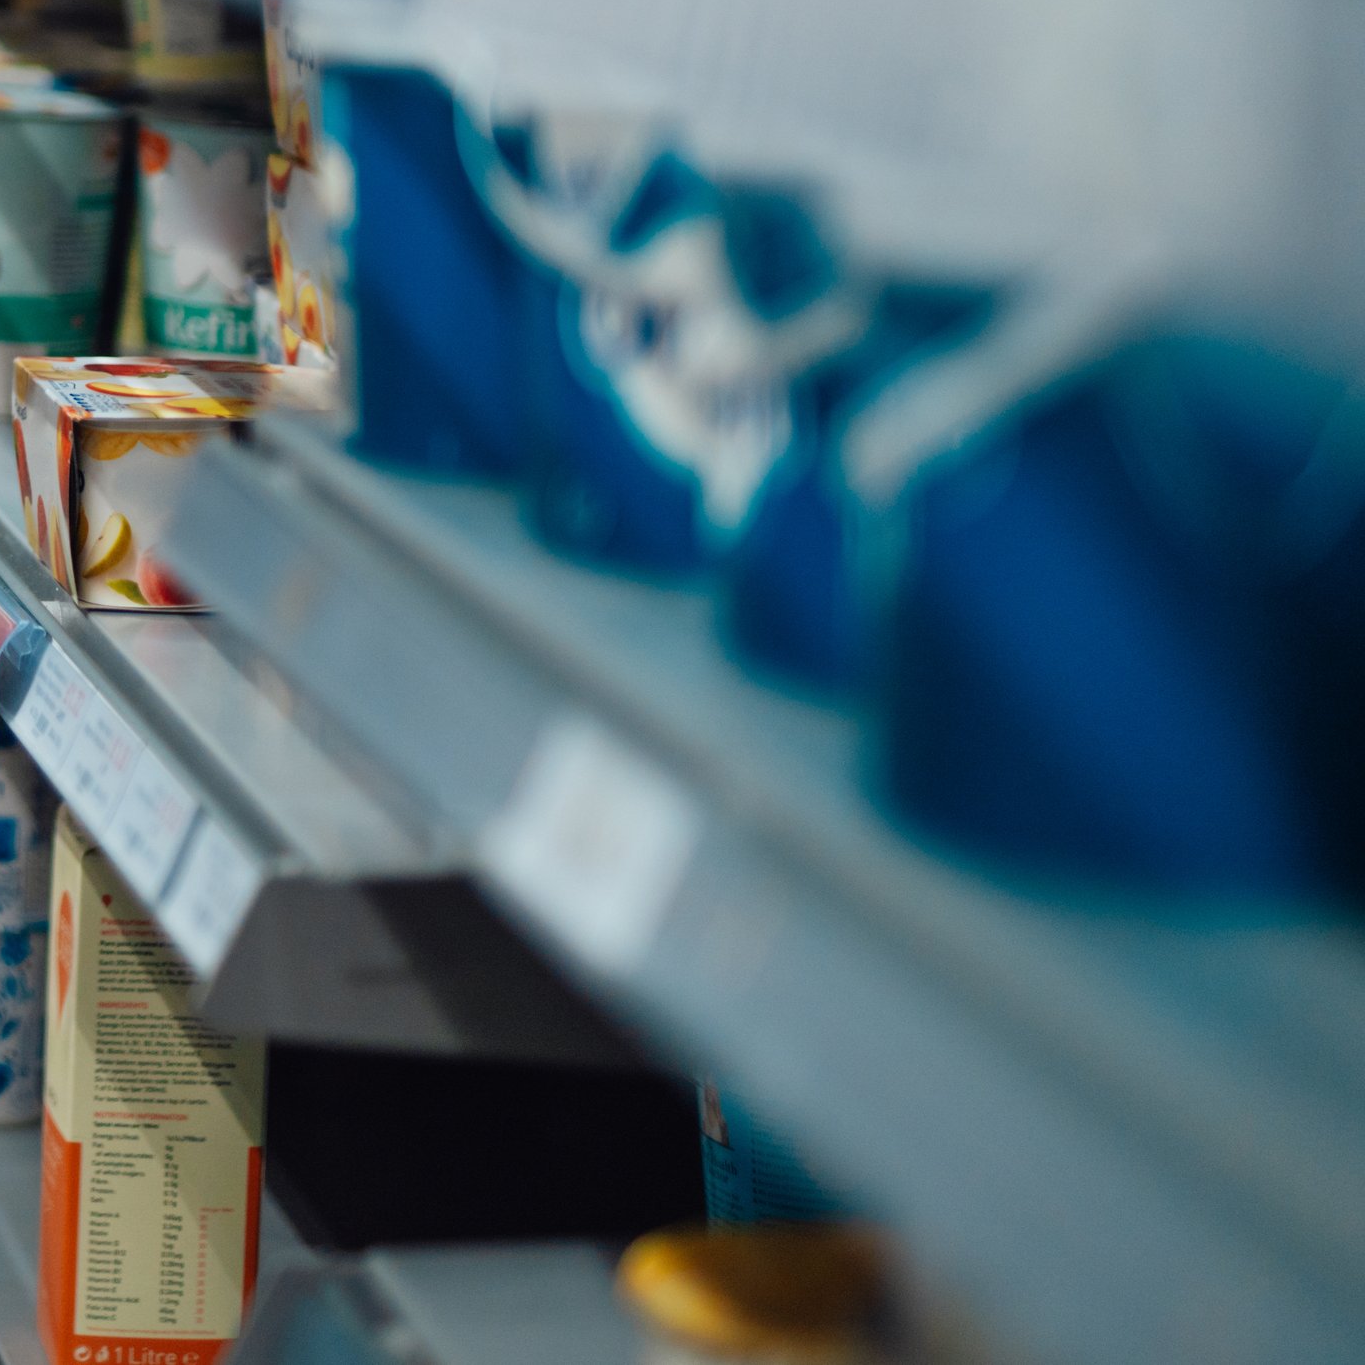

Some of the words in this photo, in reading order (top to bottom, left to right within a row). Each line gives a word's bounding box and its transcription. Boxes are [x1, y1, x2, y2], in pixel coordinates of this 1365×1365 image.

[164, 305, 257, 347] Kefir
[115, 1346, 123, 1365] 1
[128, 1346, 178, 1365] Litre
